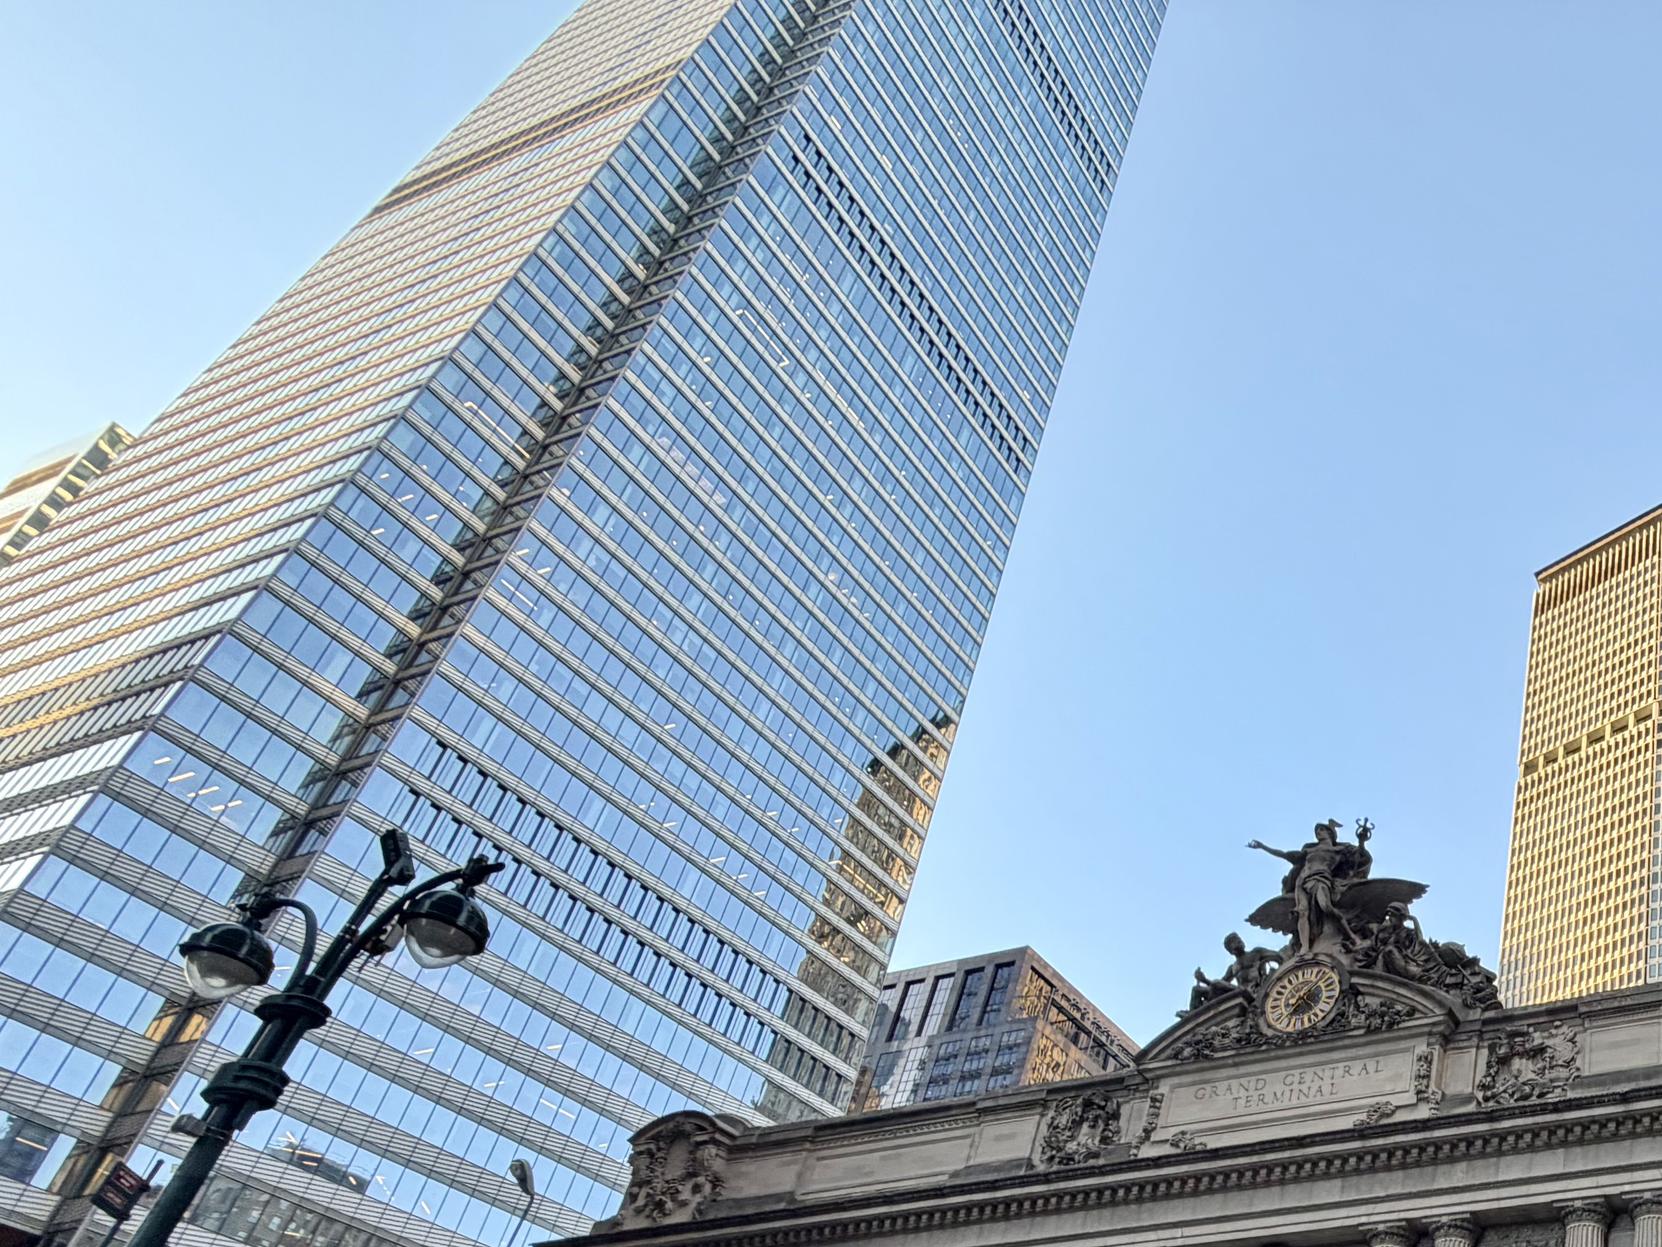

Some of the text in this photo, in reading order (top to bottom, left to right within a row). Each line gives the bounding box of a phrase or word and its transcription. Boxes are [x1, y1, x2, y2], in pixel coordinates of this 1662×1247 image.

[1193, 1059, 1385, 1101] GRAND CENTRAL
[1232, 1082, 1338, 1110] TERMINAL
